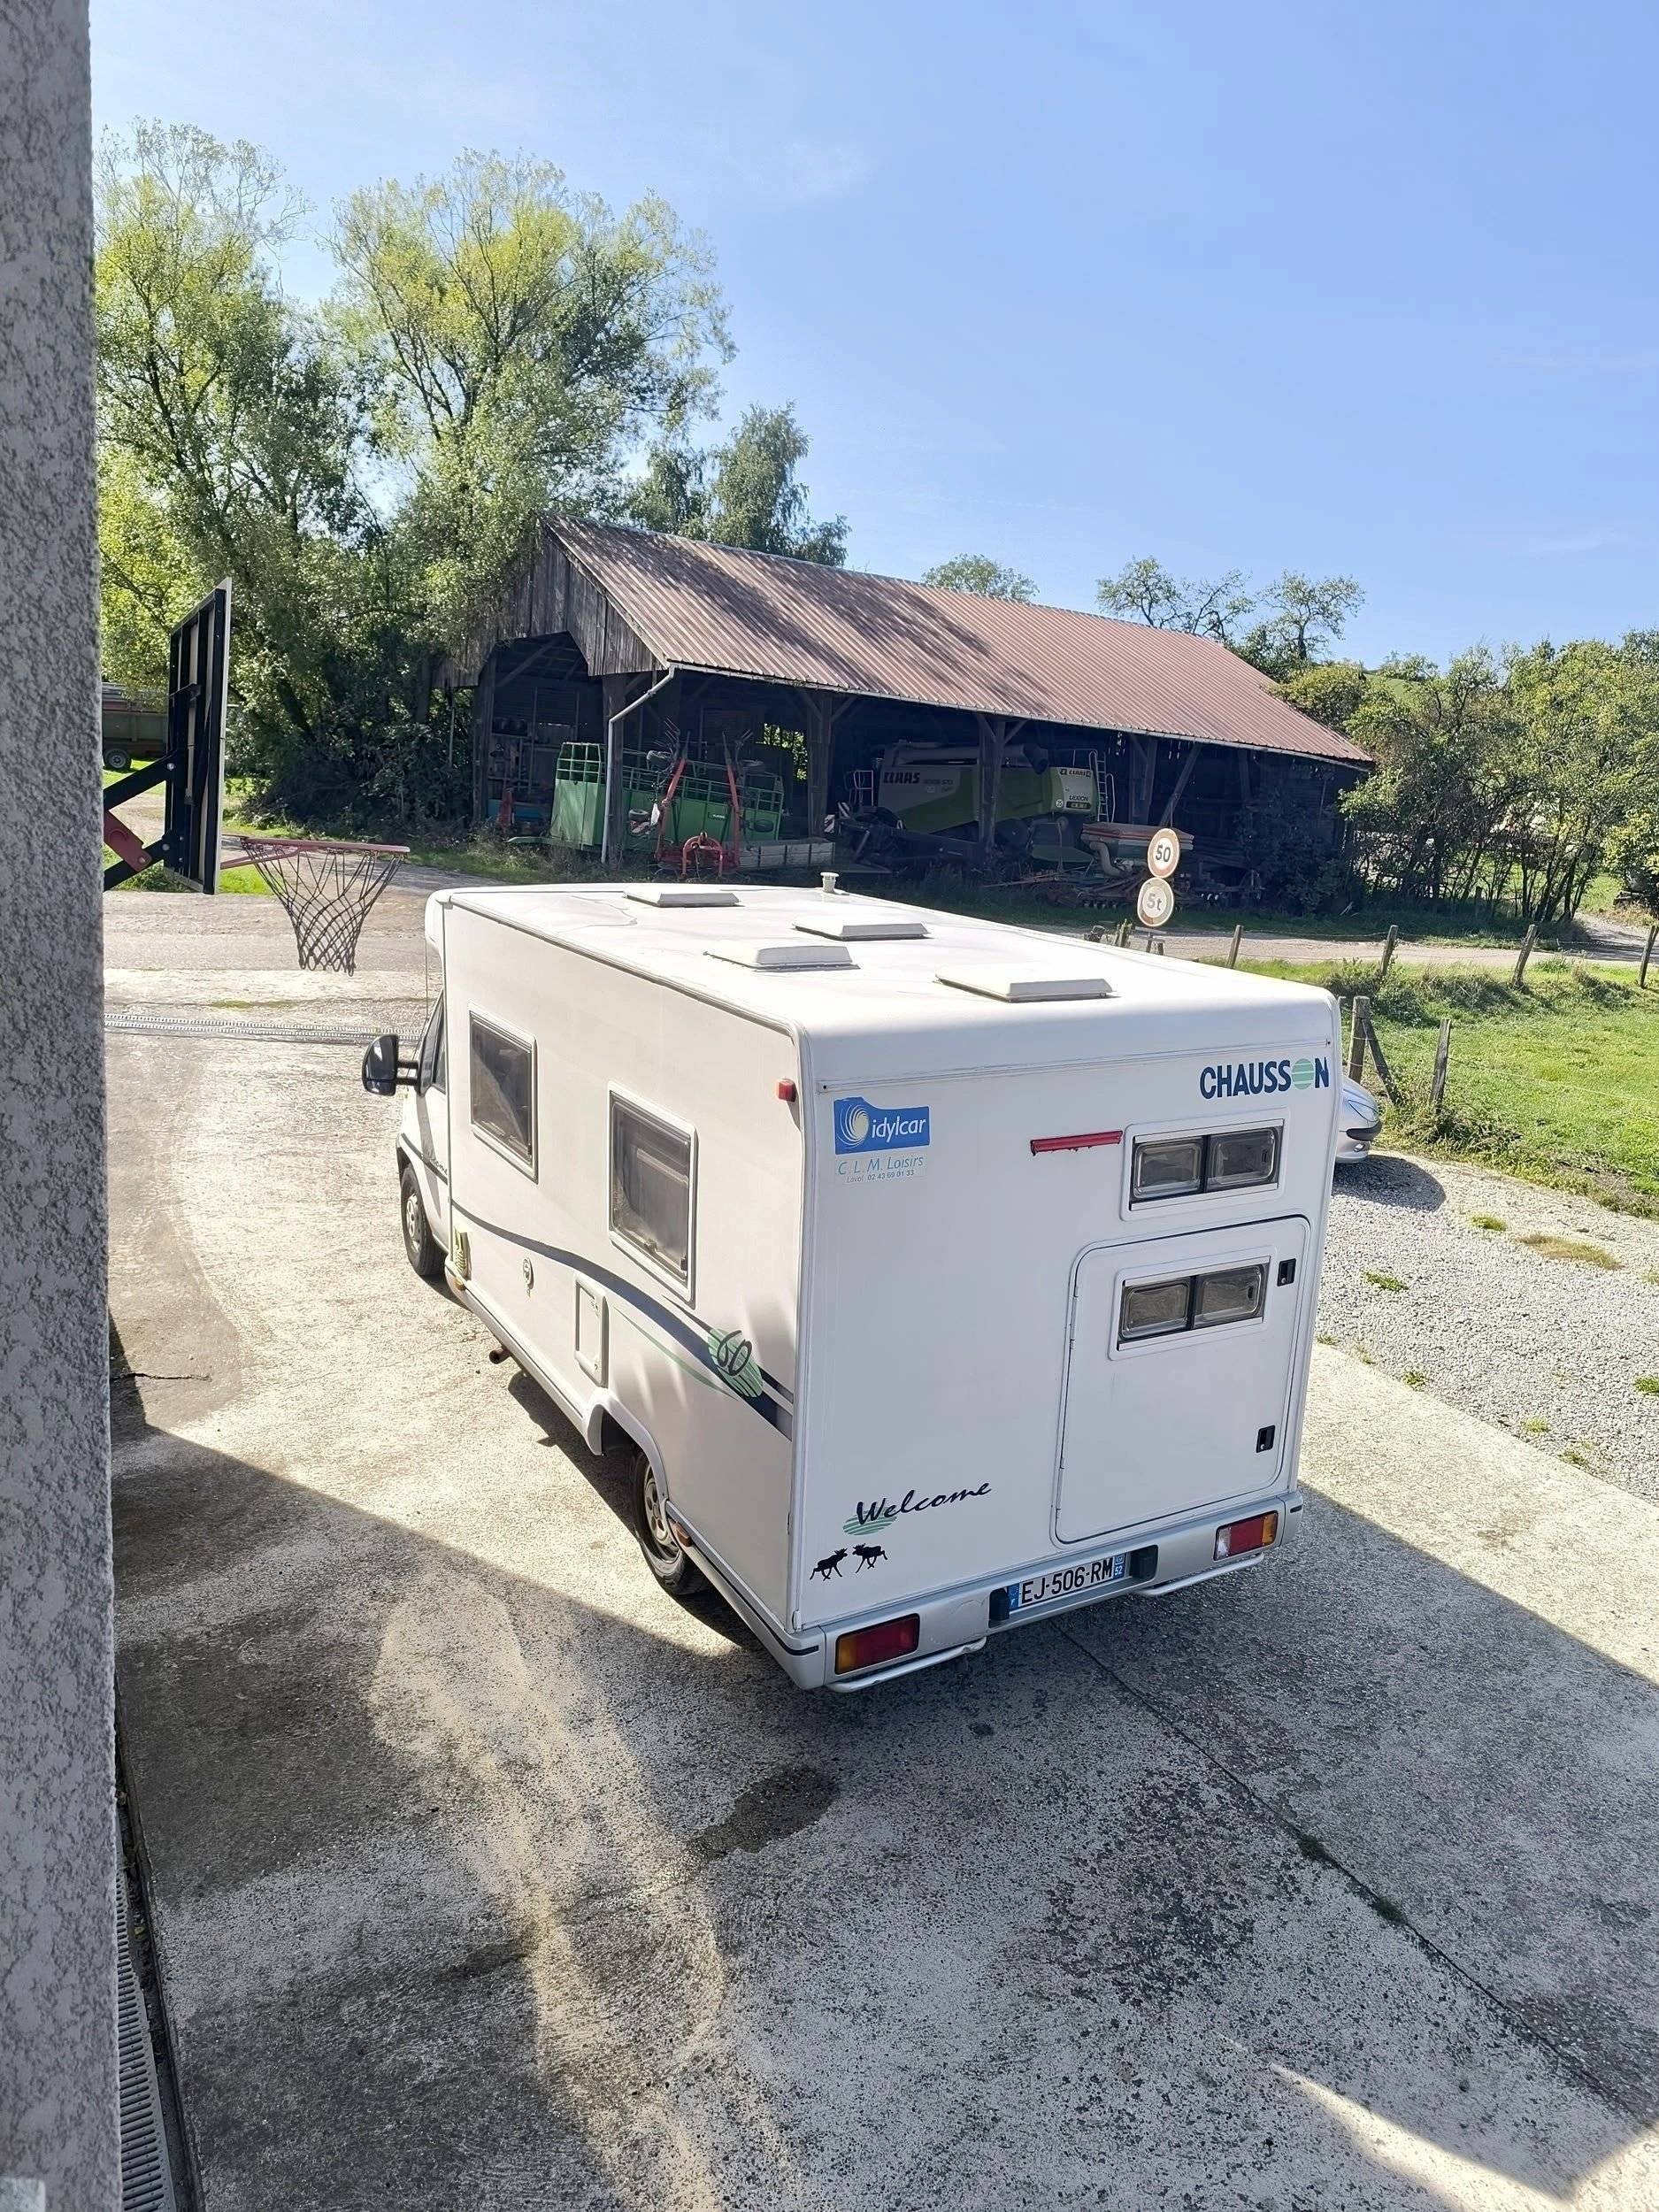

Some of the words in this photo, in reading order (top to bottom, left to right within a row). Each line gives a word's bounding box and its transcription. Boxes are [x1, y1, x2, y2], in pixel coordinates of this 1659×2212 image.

[1155, 843, 1171, 863] 50
[1146, 892, 1163, 911] 5t
[872, 1116, 926, 1143] idylcar
[887, 1156, 924, 1171] Loisirs
[856, 1482, 992, 1525] Welcome
[1021, 1557, 1114, 1604] EJ-506-RM
[1114, 1565, 1123, 1576] 52
